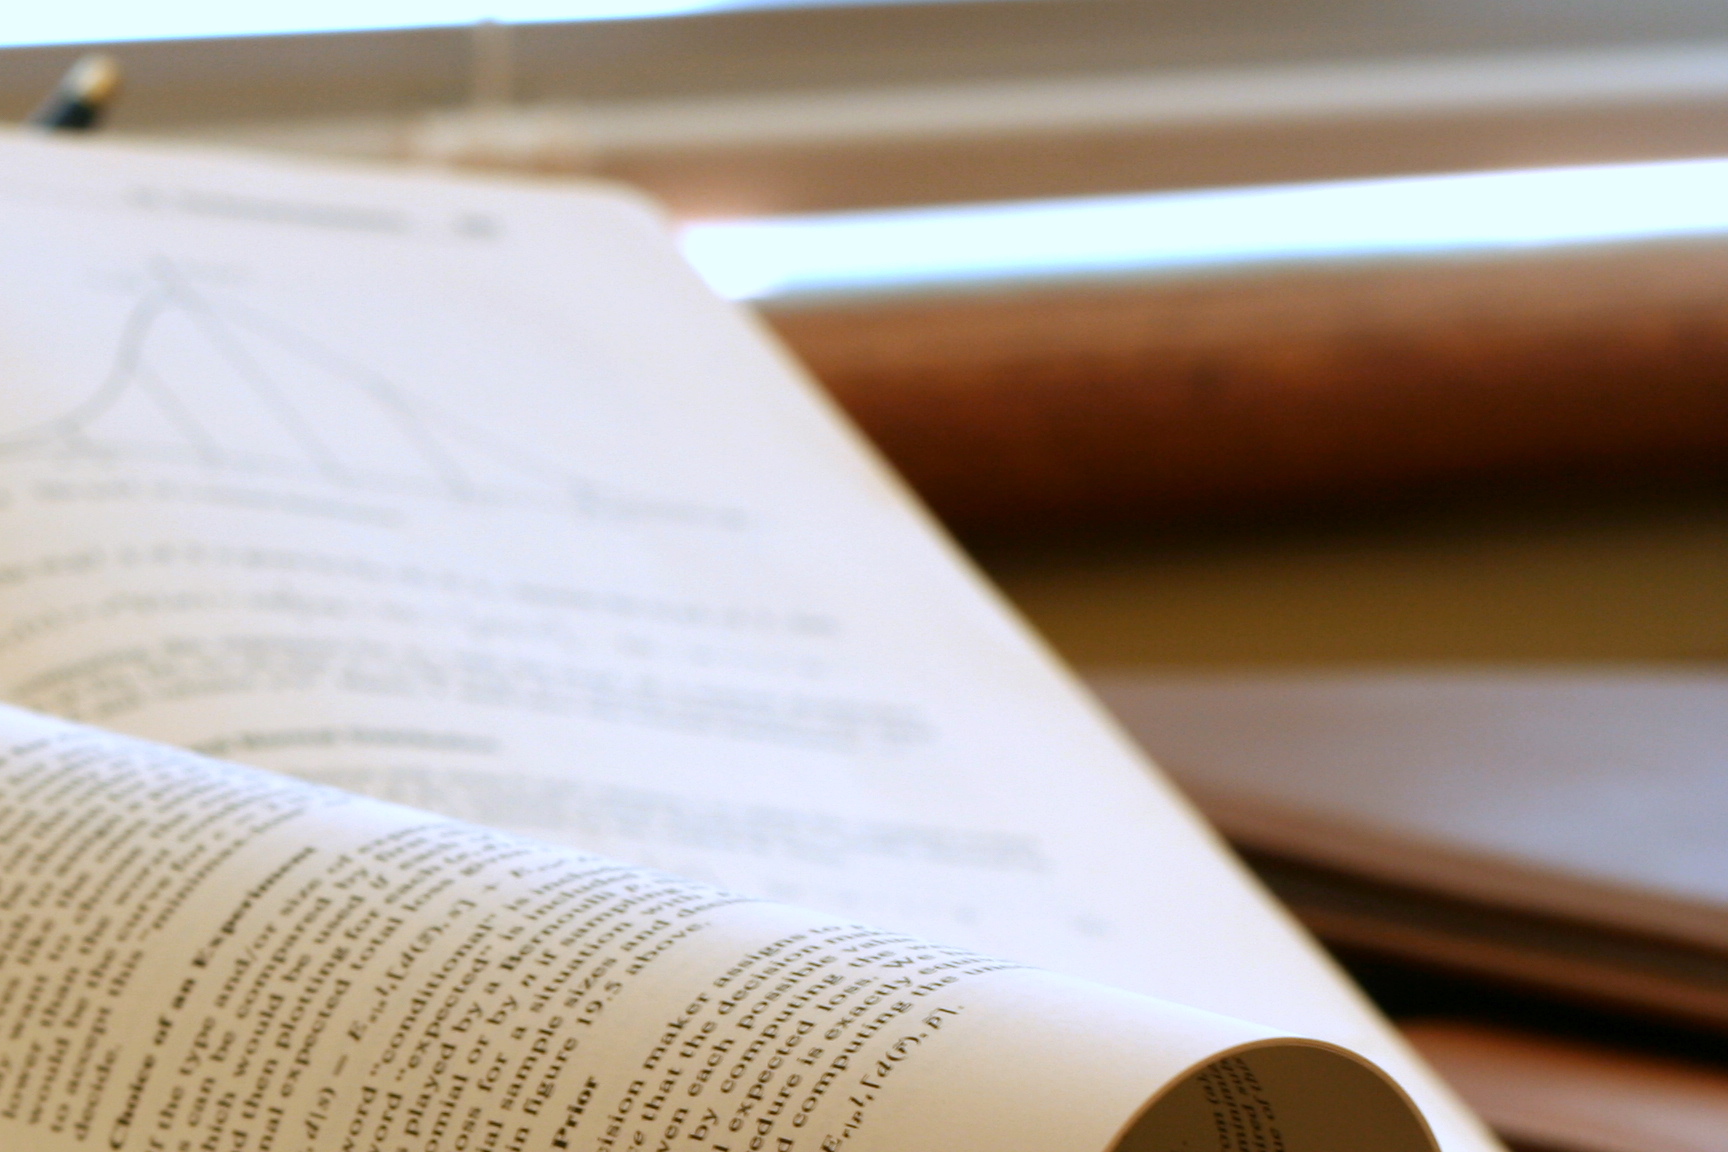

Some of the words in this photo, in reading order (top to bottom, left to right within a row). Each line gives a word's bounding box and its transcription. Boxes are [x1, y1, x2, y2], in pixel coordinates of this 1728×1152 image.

[66, 1006, 112, 1095] accept
[108, 950, 144, 997] this
[108, 1054, 156, 1151] Choice
[153, 1014, 173, 1047] of
[173, 977, 196, 1010] an
[191, 847, 316, 968] Experiment
[158, 1086, 184, 1130] the
[179, 1016, 216, 1076] type
[215, 922, 276, 1009] and/or
[186, 1076, 216, 1128] can
[236, 897, 331, 1019] compared
[233, 991, 284, 1078] would
[281, 954, 311, 983] be
[312, 894, 365, 944] used
[240, 1058, 279, 1121] then
[275, 945, 350, 1051] plotting
[344, 909, 379, 940] for
[279, 976, 352, 1098] expected
[350, 916, 404, 972] total
[466, 1034, 490, 1065] or
[476, 1051, 509, 1093] for
[530, 920, 634, 1014] situation
[500, 1015, 564, 1112] sample
[564, 956, 618, 1009] sizes
[523, 1035, 579, 1117] figure
[575, 980, 623, 1028] 19.5
[625, 919, 713, 977] above.
[641, 1066, 682, 1123] that
[678, 1018, 718, 1061] the
[717, 943, 822, 1016] decision
[643, 992, 711, 1071] maker
[713, 933, 808, 989] assigns
[686, 1036, 736, 1098] each
[735, 953, 838, 1032] possible
[687, 1106, 719, 1143] by
[719, 972, 846, 1095] computing
[727, 1018, 817, 1134] expected
[817, 975, 880, 1013] loss.
[791, 999, 915, 1130] computing
[823, 975, 914, 1042] exactly
[29, 1036, 70, 1125] would
[75, 1044, 123, 1141] decide.
[404, 1041, 458, 1138] played
[451, 1000, 484, 1034] by
[550, 1075, 599, 1151] Prior
